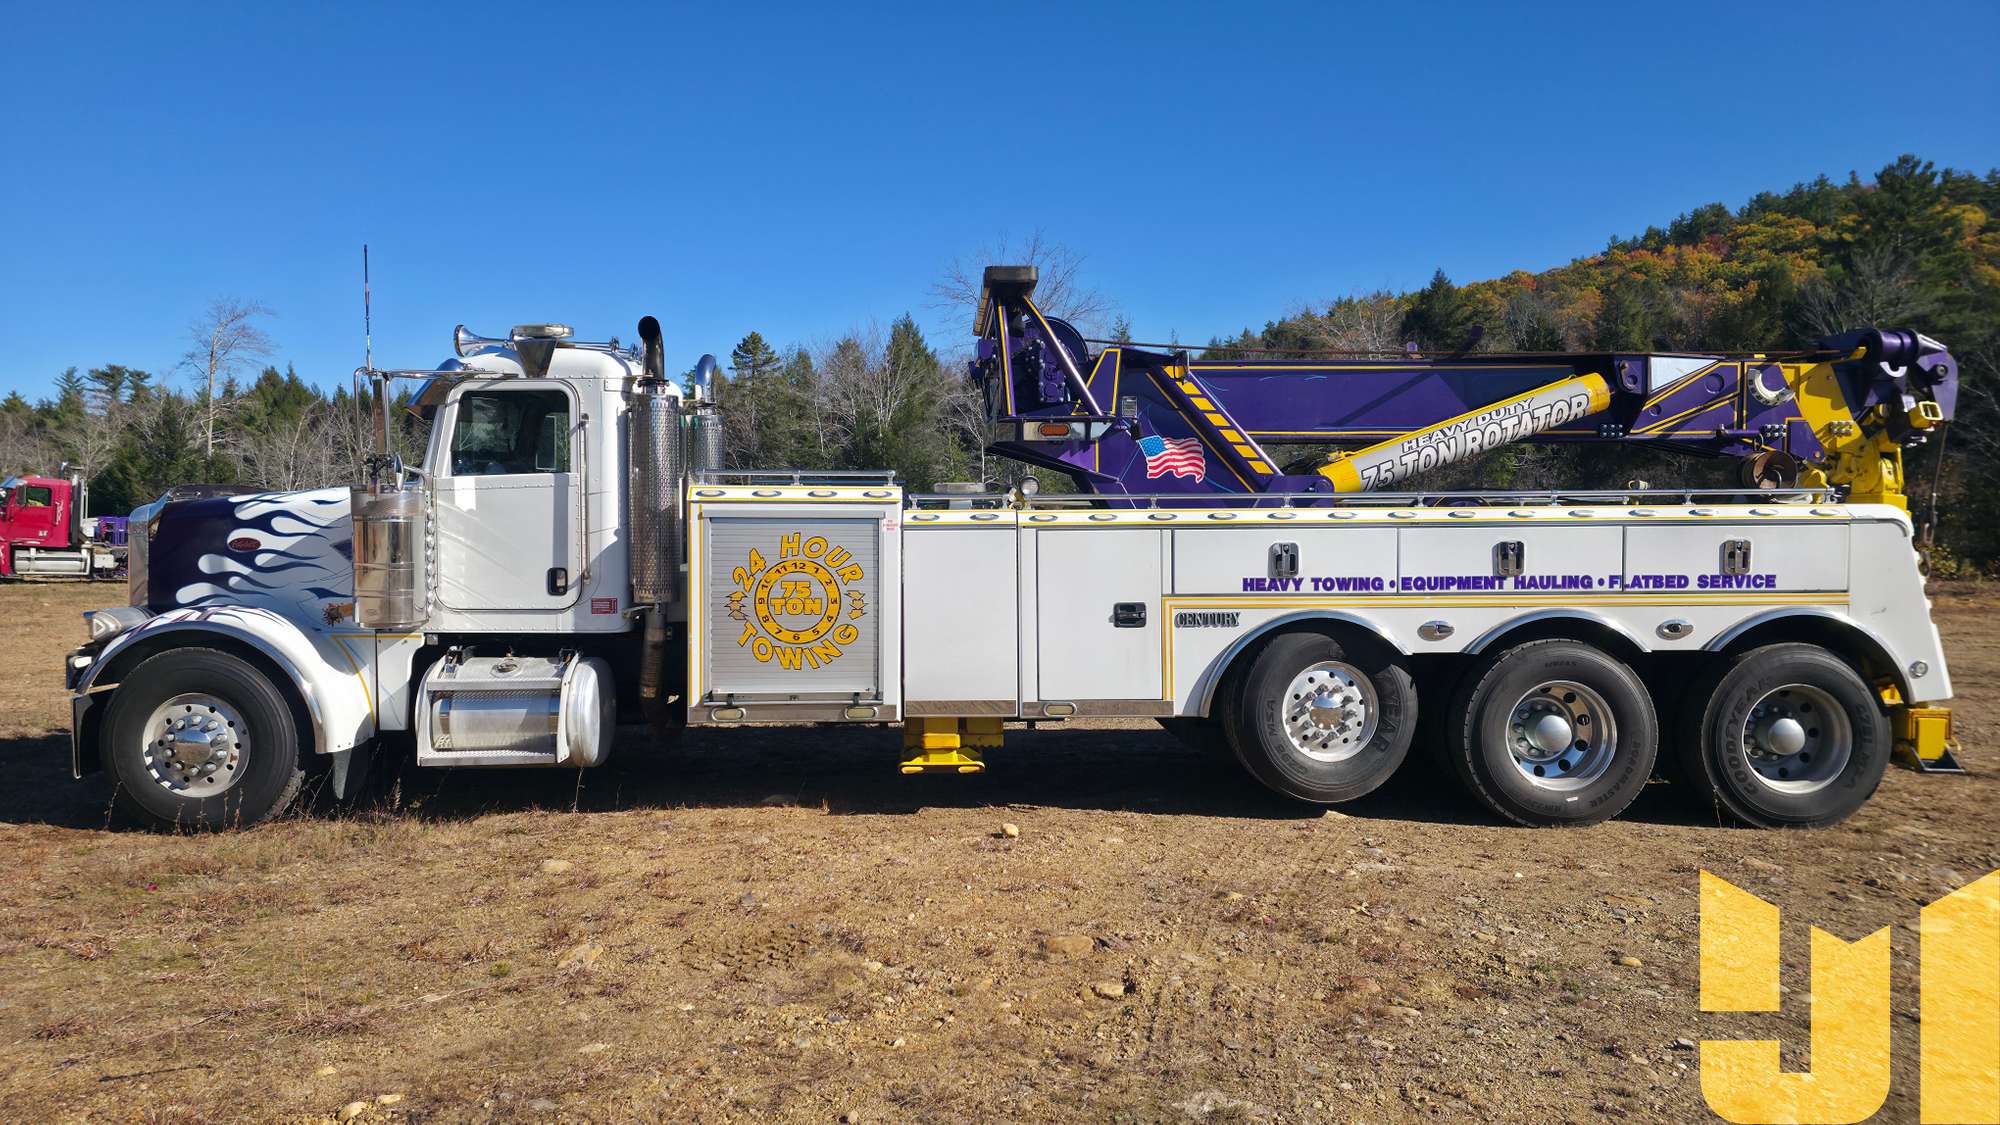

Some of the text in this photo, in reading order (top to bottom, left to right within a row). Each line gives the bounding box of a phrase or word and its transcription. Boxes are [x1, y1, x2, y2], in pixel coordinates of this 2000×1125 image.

[1361, 393, 1589, 491] 75 TON ROTATOR
[1401, 397, 1534, 453] HEAVY DUTY
[732, 532, 864, 593] 24 HOUR
[781, 580, 811, 598] 75
[1242, 574, 1777, 592] HEAVY TOWING EQUIPMENT HAULING FLATBED SERVICE
[770, 598, 822, 615] TON
[1174, 612, 1240, 628] CENTURY
[737, 620, 858, 670] TOWING
